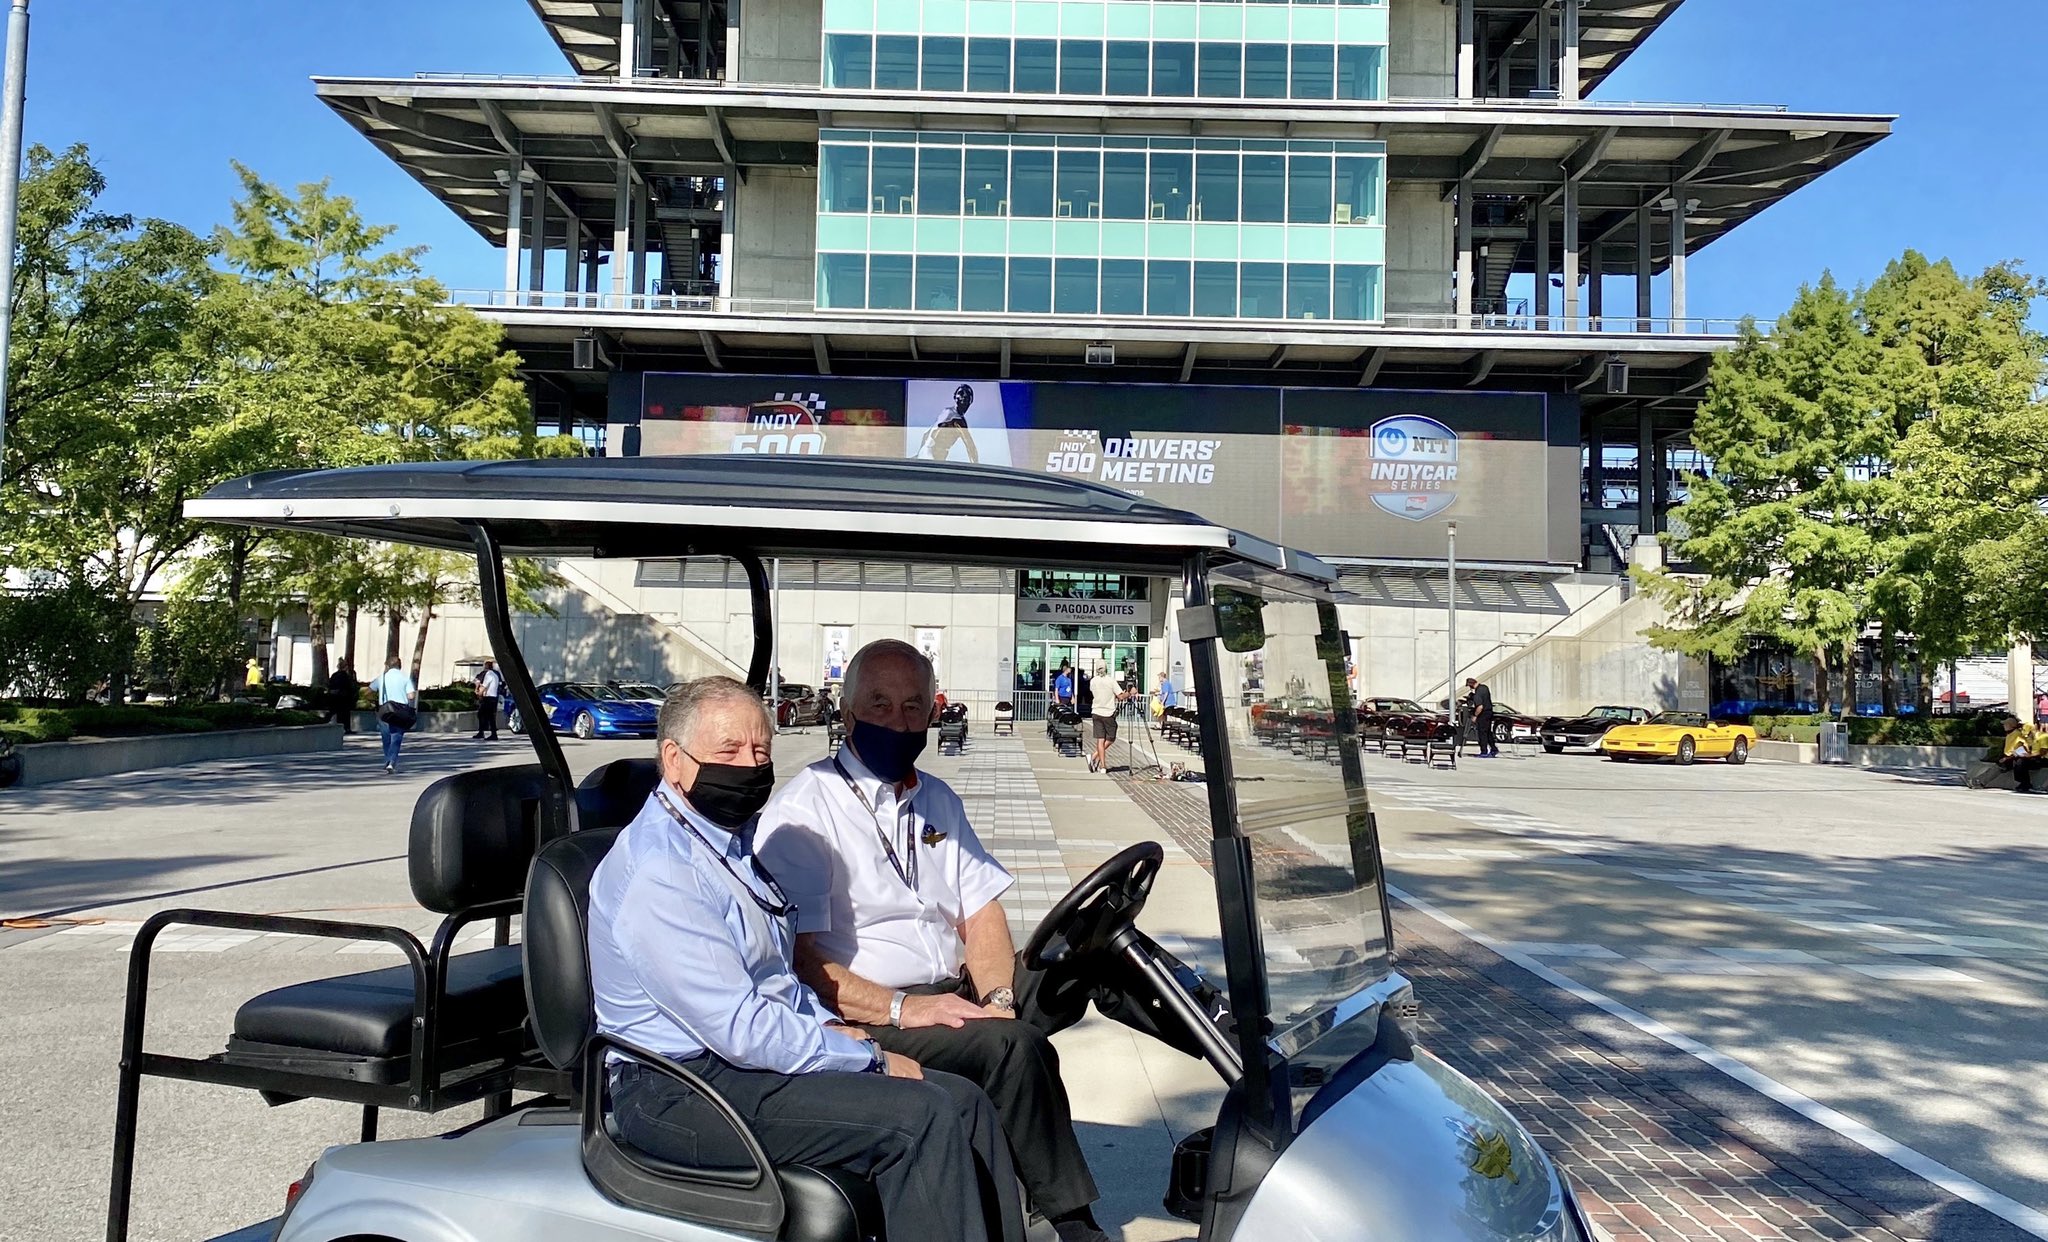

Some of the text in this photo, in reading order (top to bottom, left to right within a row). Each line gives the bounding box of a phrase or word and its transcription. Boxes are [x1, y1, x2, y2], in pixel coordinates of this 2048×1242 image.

[753, 413, 802, 431] INDY
[732, 433, 822, 455] 500
[1059, 441, 1087, 452] INDY
[1412, 436, 1449, 454] NTT
[1046, 452, 1096, 473] 500
[1370, 462, 1458, 481] INDYCAR
[1100, 461, 1215, 484] MEETING
[1391, 481, 1441, 491] SERIES
[1055, 603, 1134, 615] PAGODA SUITES
